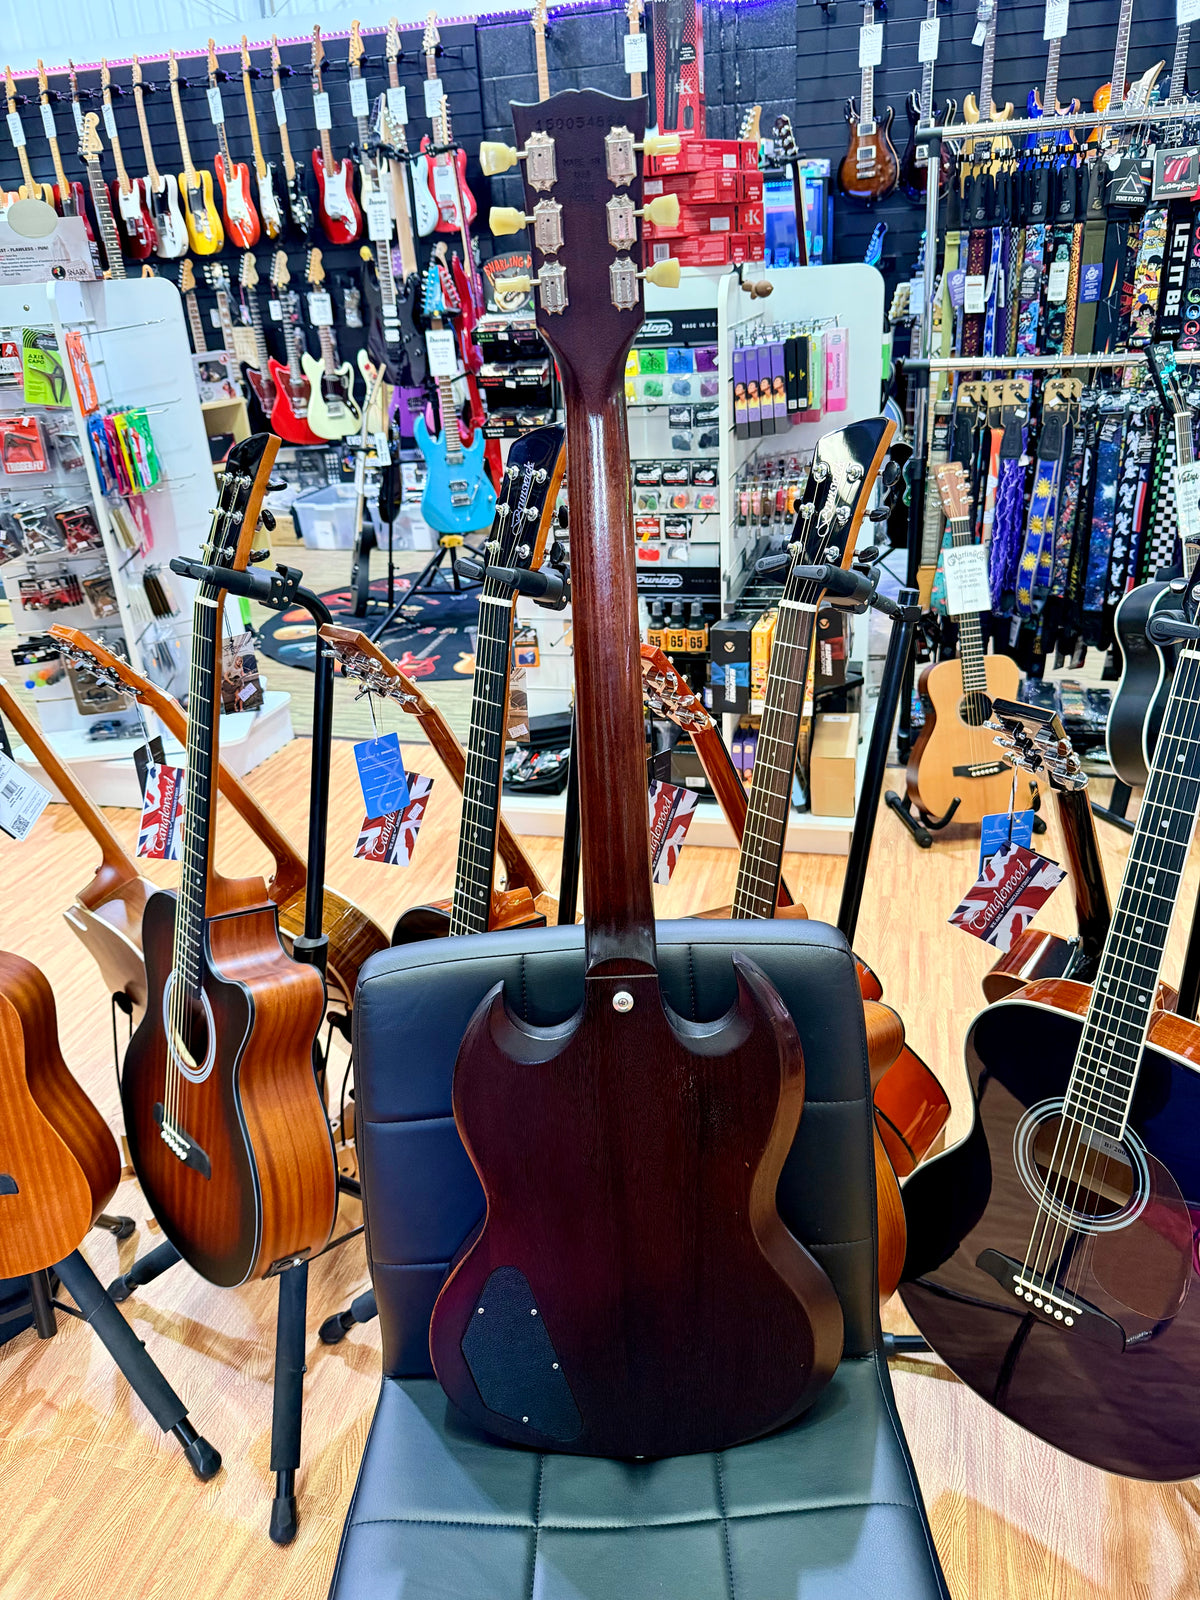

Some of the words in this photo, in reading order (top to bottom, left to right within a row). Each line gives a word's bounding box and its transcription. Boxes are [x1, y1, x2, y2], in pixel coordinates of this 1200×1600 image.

[1172, 222, 1191, 262] LET
[483, 255, 524, 277] SNARLING
[1168, 265, 1185, 287] IT
[1163, 289, 1182, 317] BE
[637, 575, 680, 586] Dunlop
[670, 635, 683, 648] 65
[690, 636, 703, 649] 65
[152, 775, 175, 855] Tanglewood
[968, 858, 1028, 930] Tanglewood
